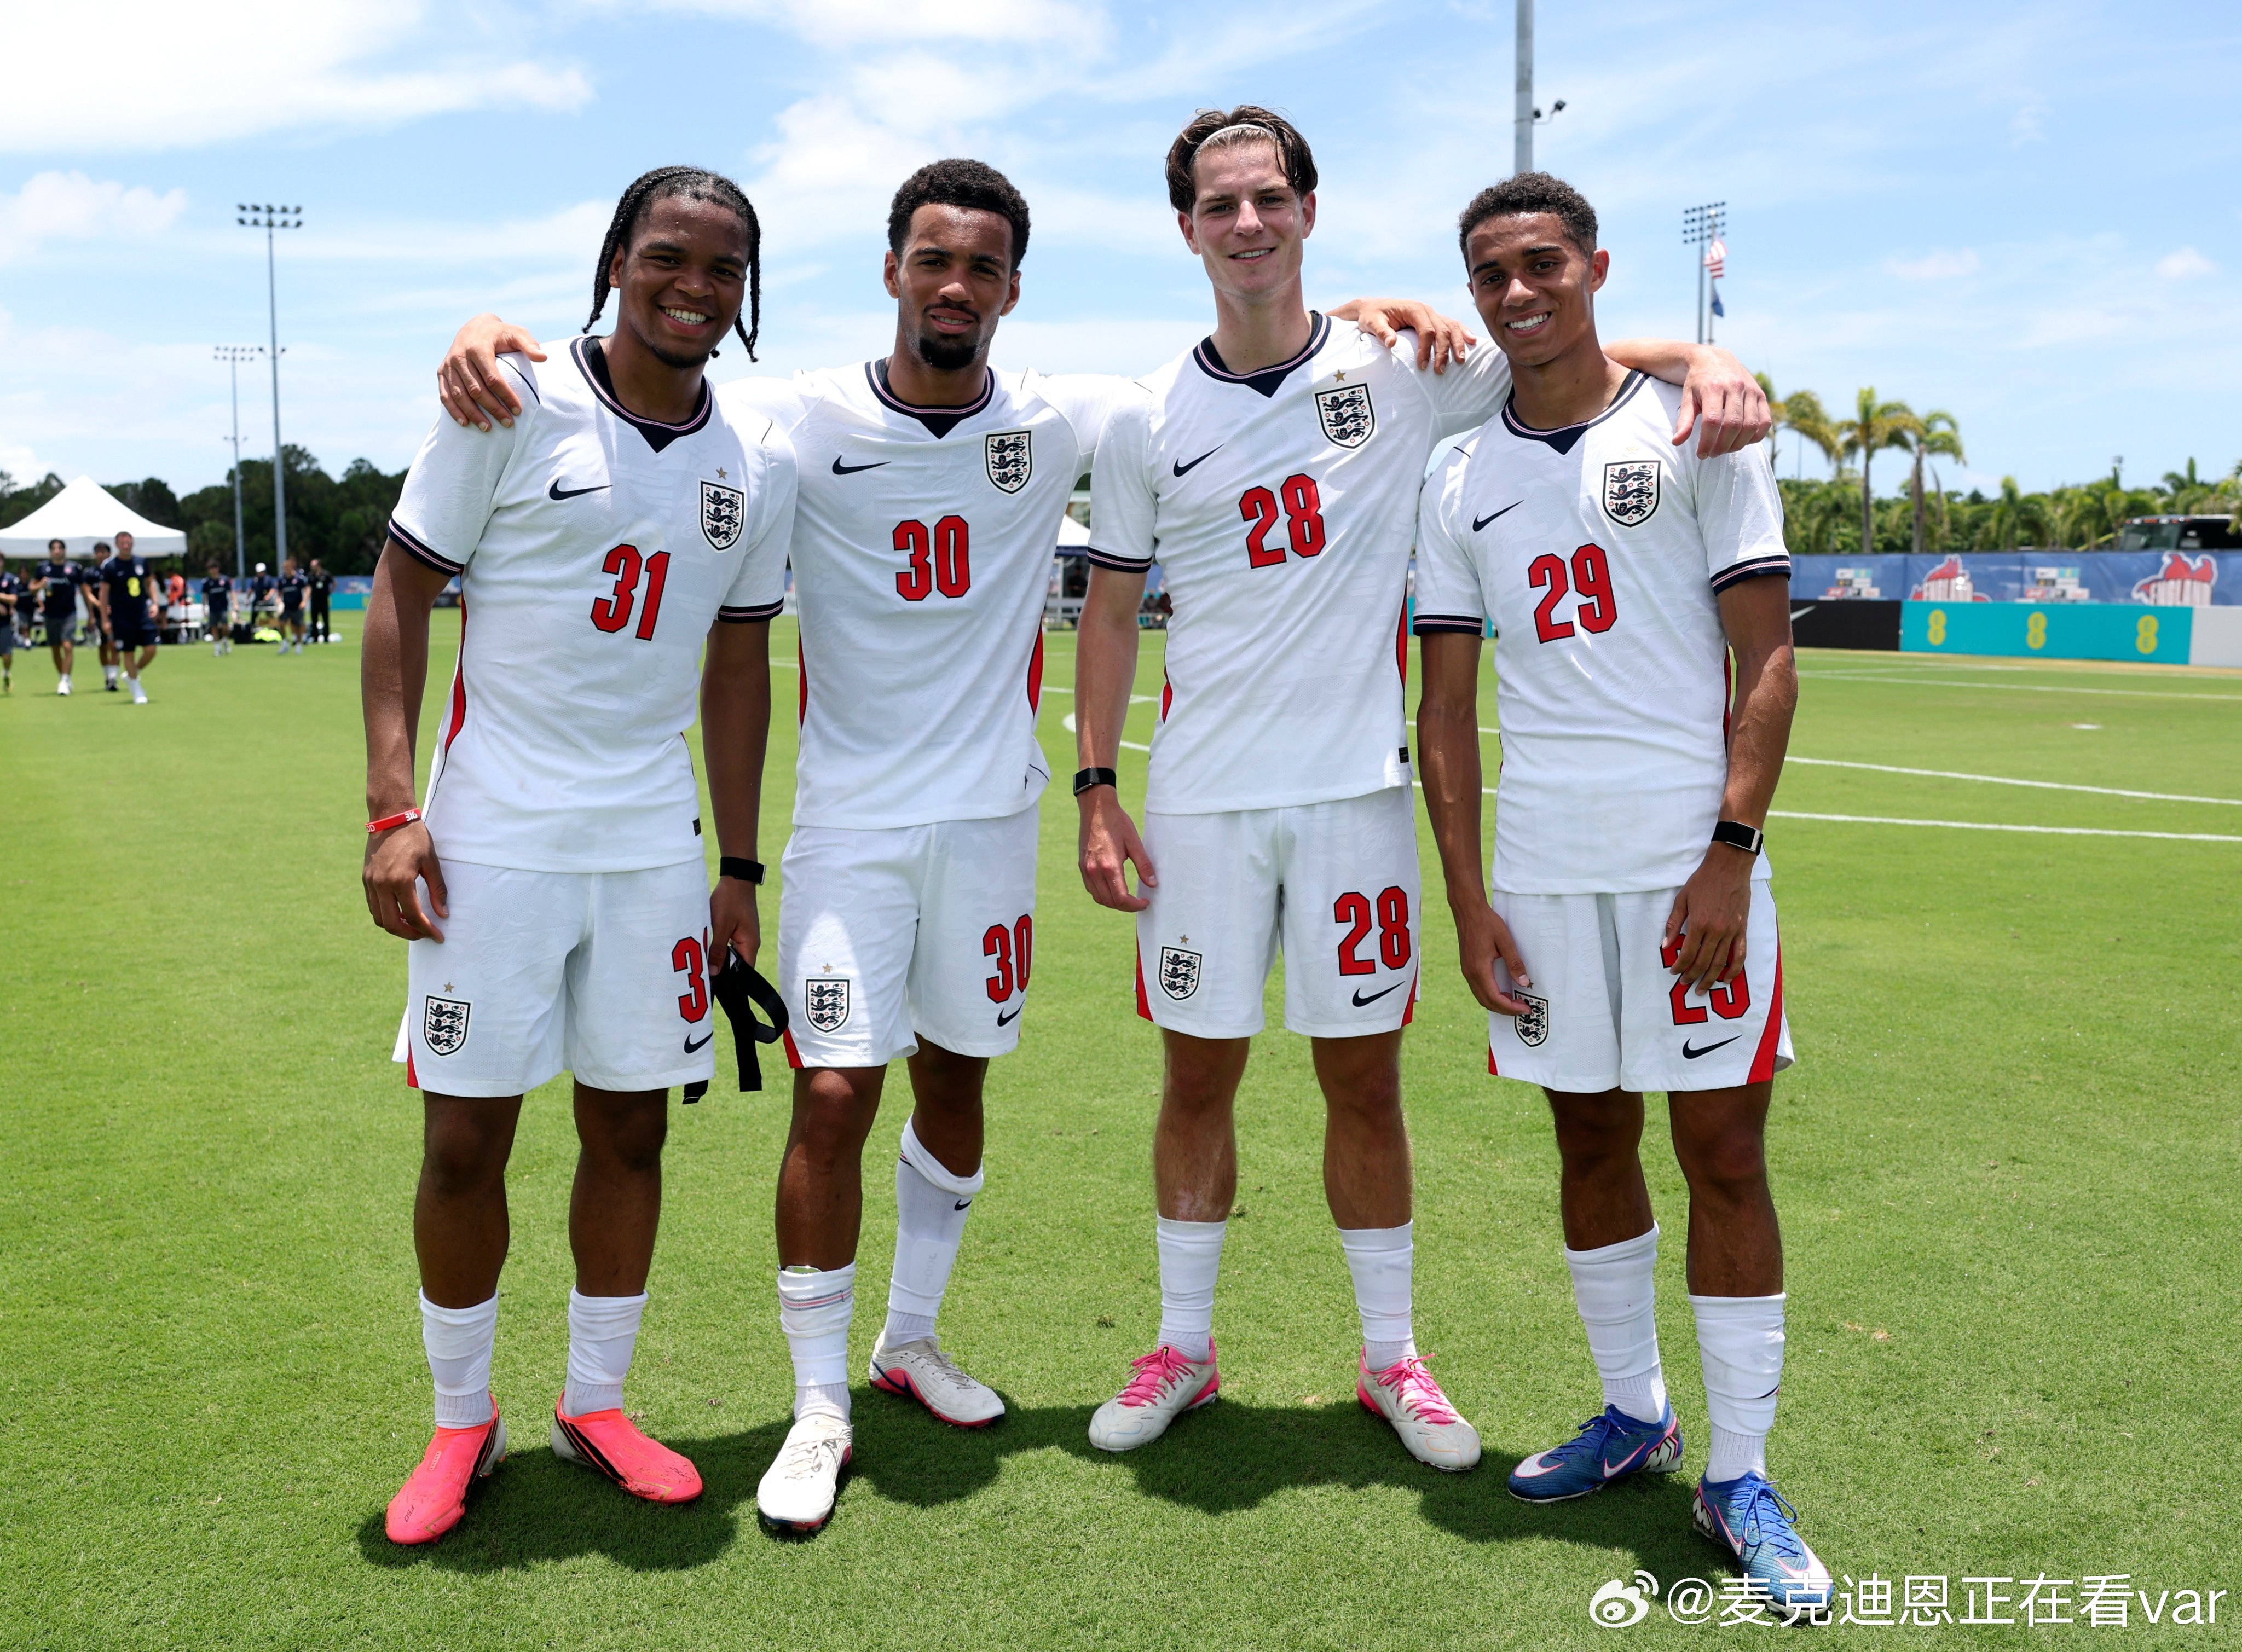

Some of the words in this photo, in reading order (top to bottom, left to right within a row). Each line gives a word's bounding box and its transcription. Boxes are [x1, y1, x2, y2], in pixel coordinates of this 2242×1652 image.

[893, 515, 970, 601] 30
[1239, 473, 1326, 569] 28
[590, 543, 671, 641] 31
[1528, 543, 1618, 644] 29
[671, 925, 708, 1024] 3
[983, 913, 1032, 1004] 30
[1333, 885, 1411, 977] 28
